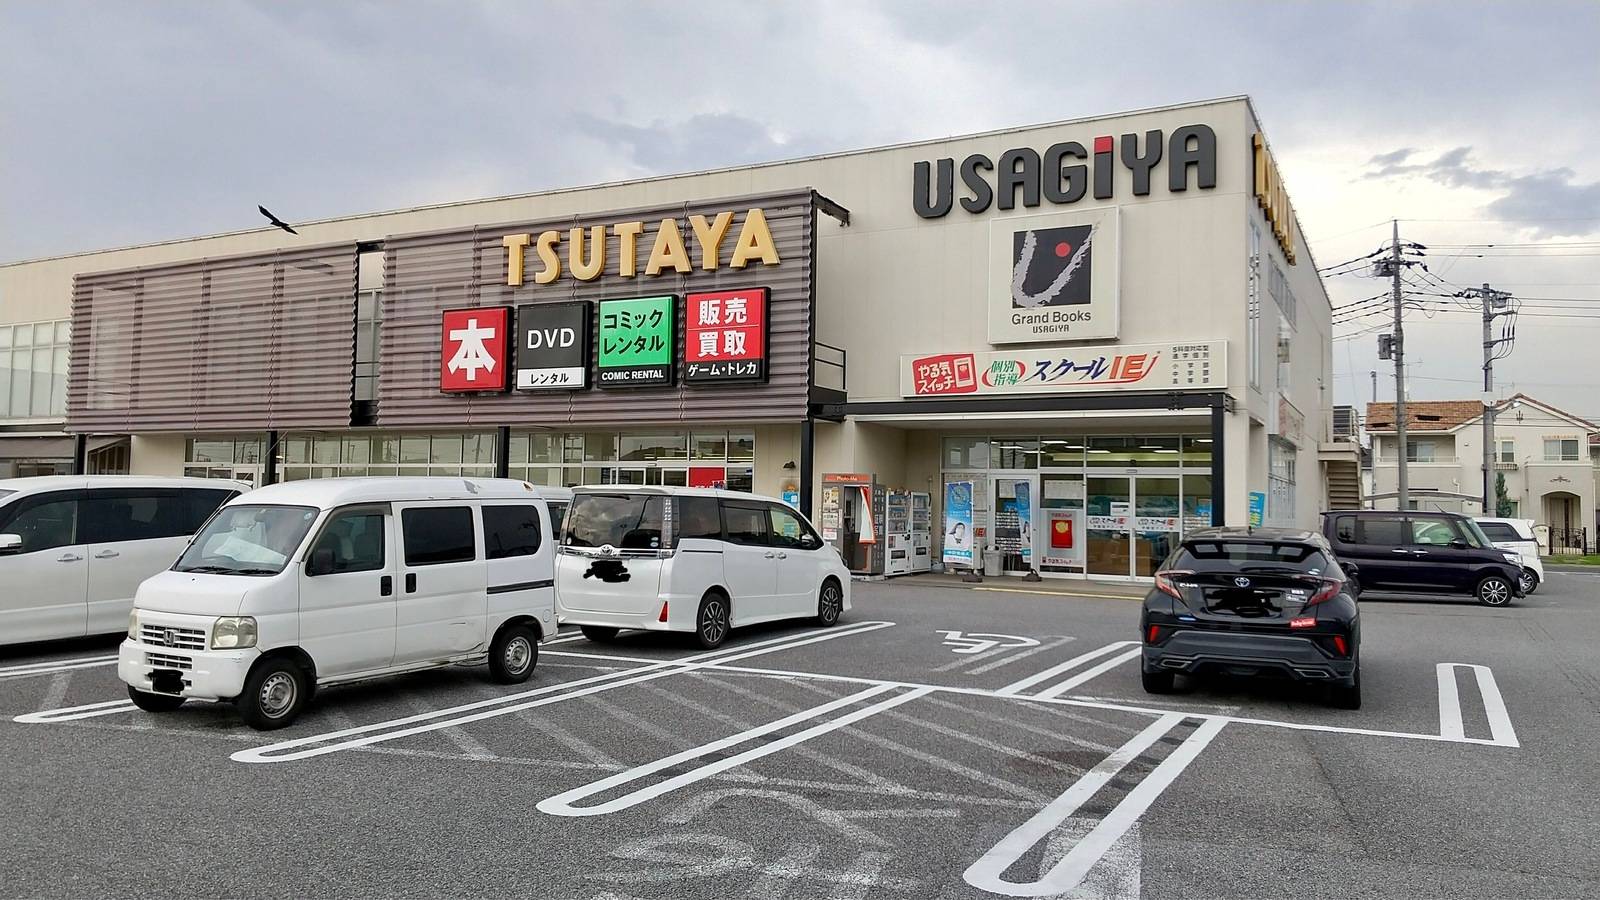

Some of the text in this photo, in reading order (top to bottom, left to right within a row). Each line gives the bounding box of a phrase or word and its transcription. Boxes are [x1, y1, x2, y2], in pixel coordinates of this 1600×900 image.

[503, 208, 780, 287] TSUTAYA
[603, 309, 664, 330] コミック
[698, 297, 748, 327] 販売
[1011, 309, 1091, 326] Grand Books
[527, 327, 575, 350] DVD
[603, 334, 665, 356] レンタル
[698, 329, 747, 358] 買取
[447, 319, 497, 381] 本
[601, 369, 664, 381] COMIC RENTAL
[688, 361, 757, 378] ゲーム・トレカ
[918, 361, 951, 378] やる気
[991, 360, 1017, 373] 個別
[530, 372, 569, 385] レンタル
[918, 377, 955, 392] スイッチ
[994, 372, 1018, 386] 指導
